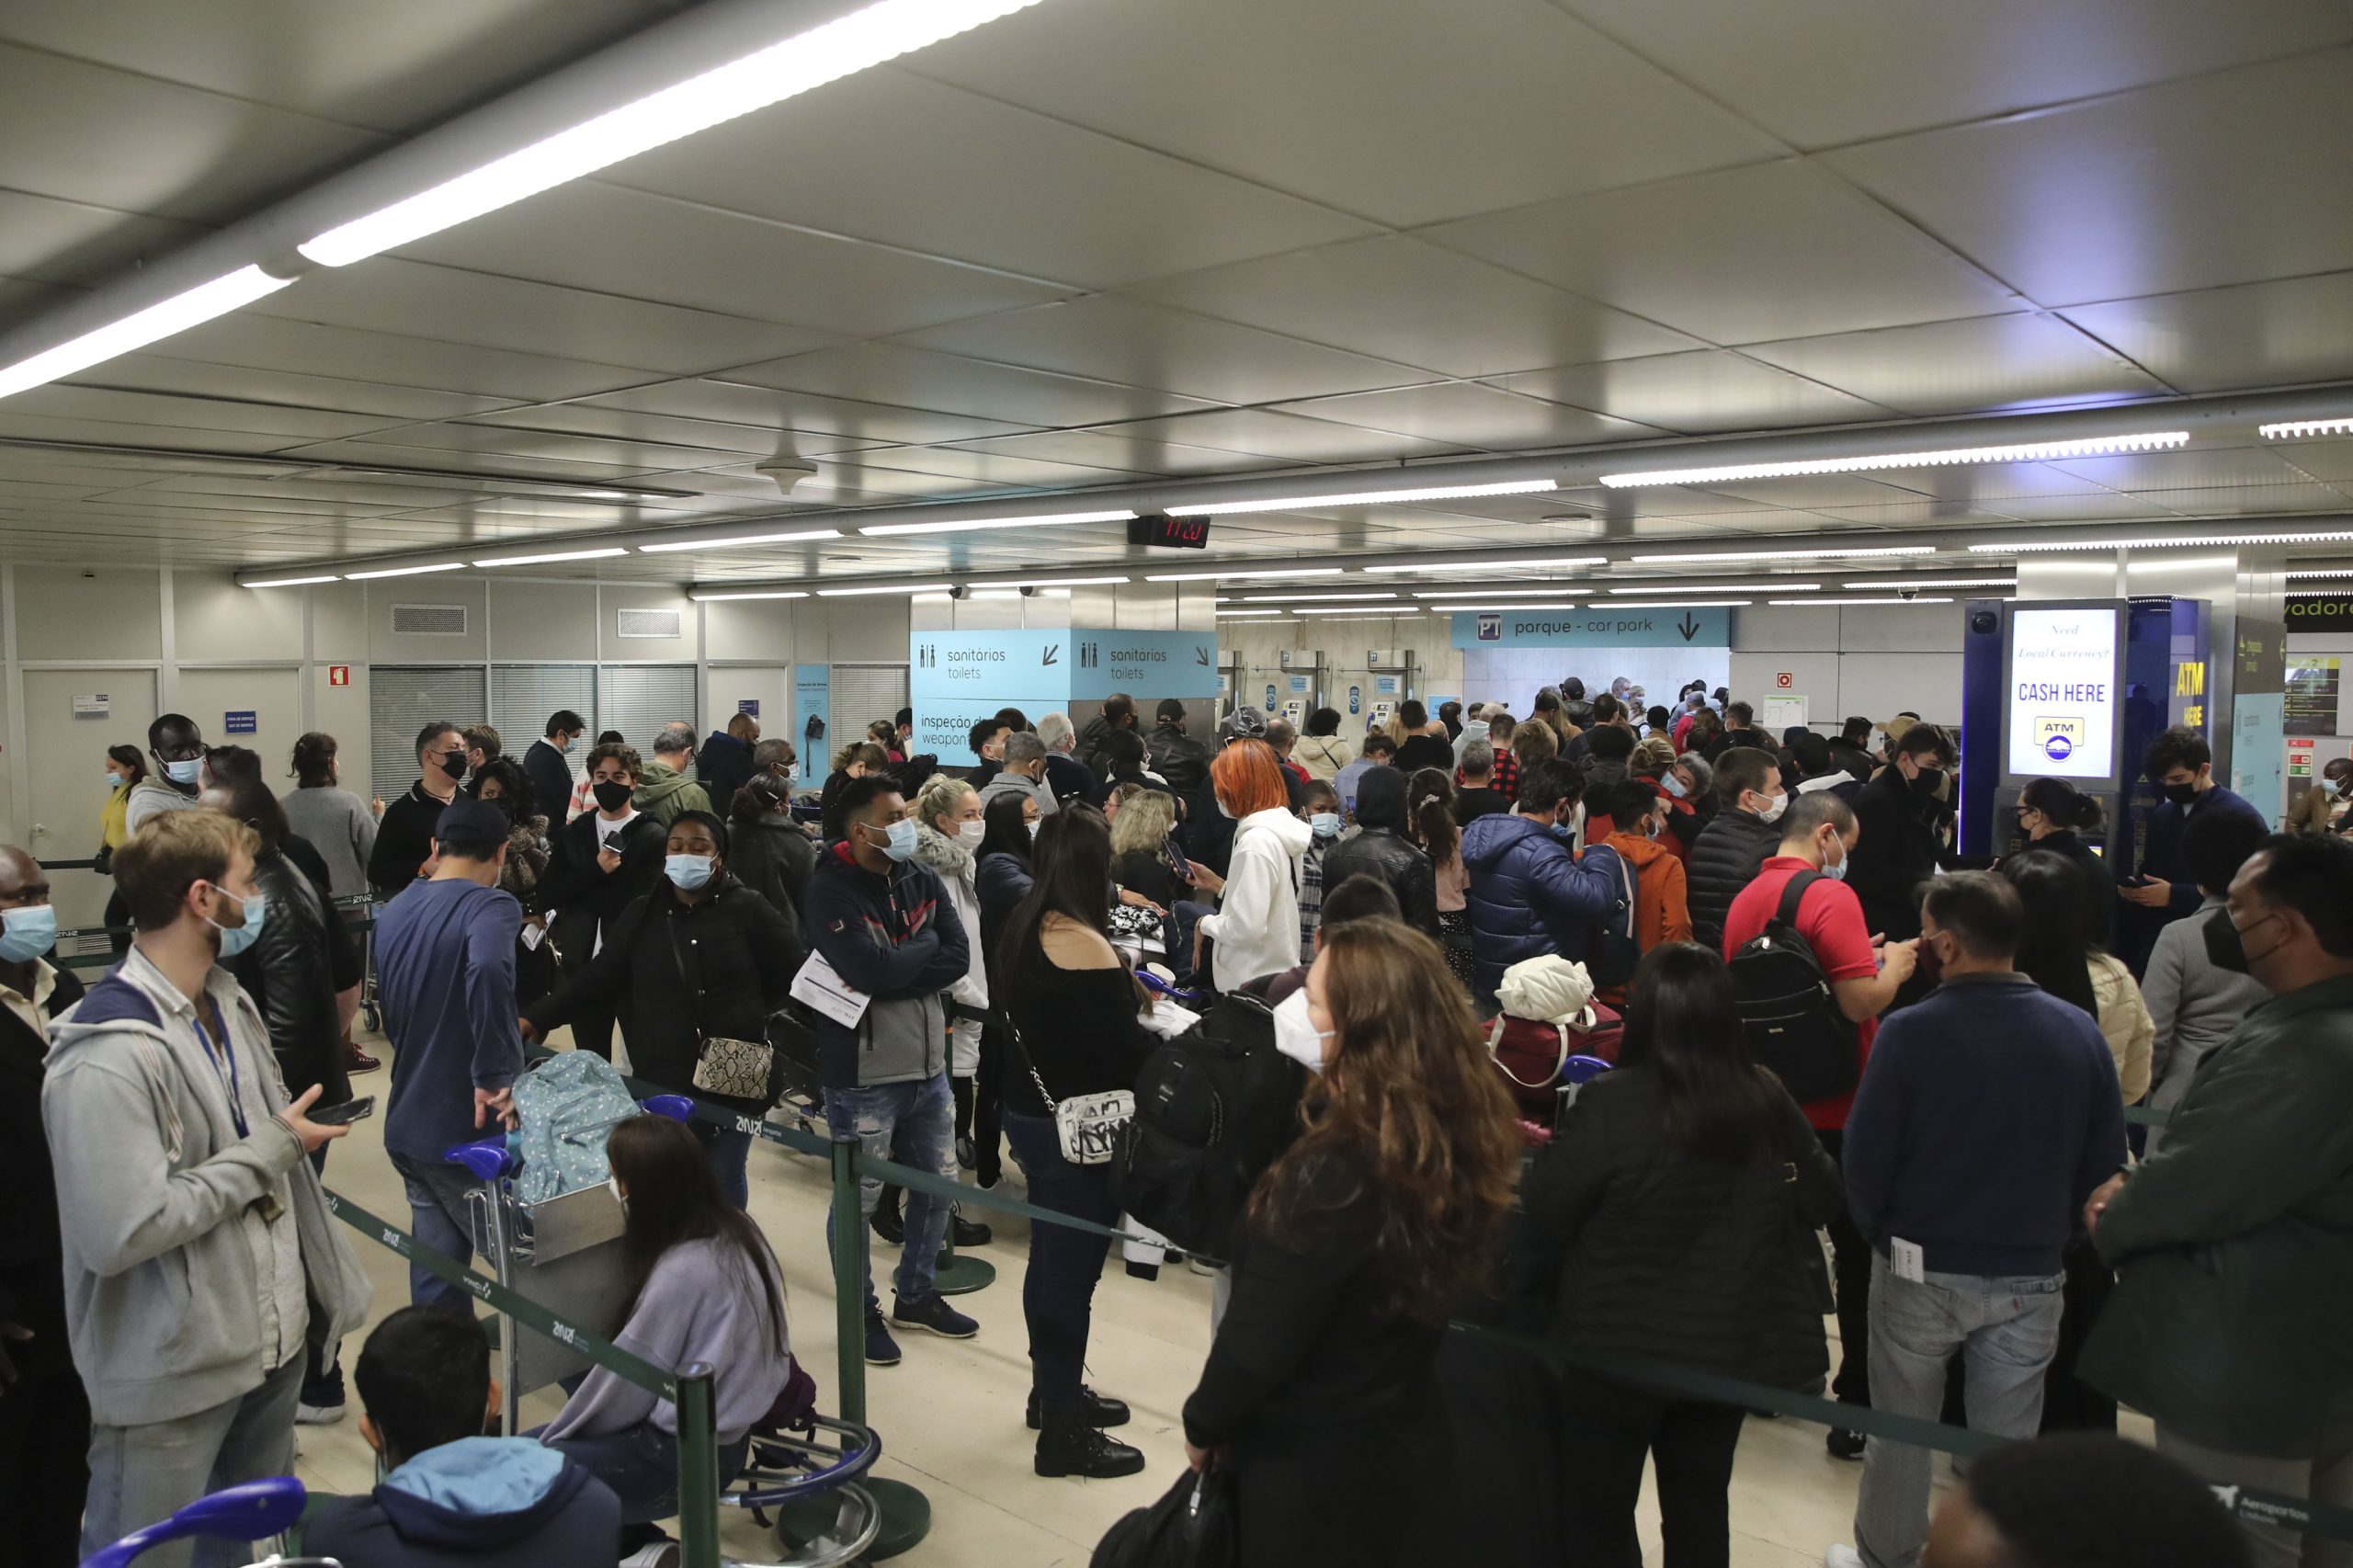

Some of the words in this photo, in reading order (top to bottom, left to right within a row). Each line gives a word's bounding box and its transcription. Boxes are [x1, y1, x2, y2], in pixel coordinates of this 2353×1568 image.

[1515, 621, 1571, 636] parque
[1587, 619, 1612, 632] car
[1617, 618, 1653, 634] park
[2052, 625, 2080, 635] Need
[948, 648, 1006, 662] sanitários
[1110, 647, 1167, 662] sanitários
[2018, 648, 2050, 658] Local
[2052, 649, 2109, 660] Currency?
[949, 667, 981, 679] toilets
[1110, 667, 1144, 679] toilets
[2176, 662, 2204, 697] ATM
[2018, 683, 2060, 701] CASH
[2064, 684, 2105, 702] HERE
[921, 714, 971, 731] inspeção
[2183, 706, 2203, 728] HERE
[2044, 723, 2074, 732] ATM
